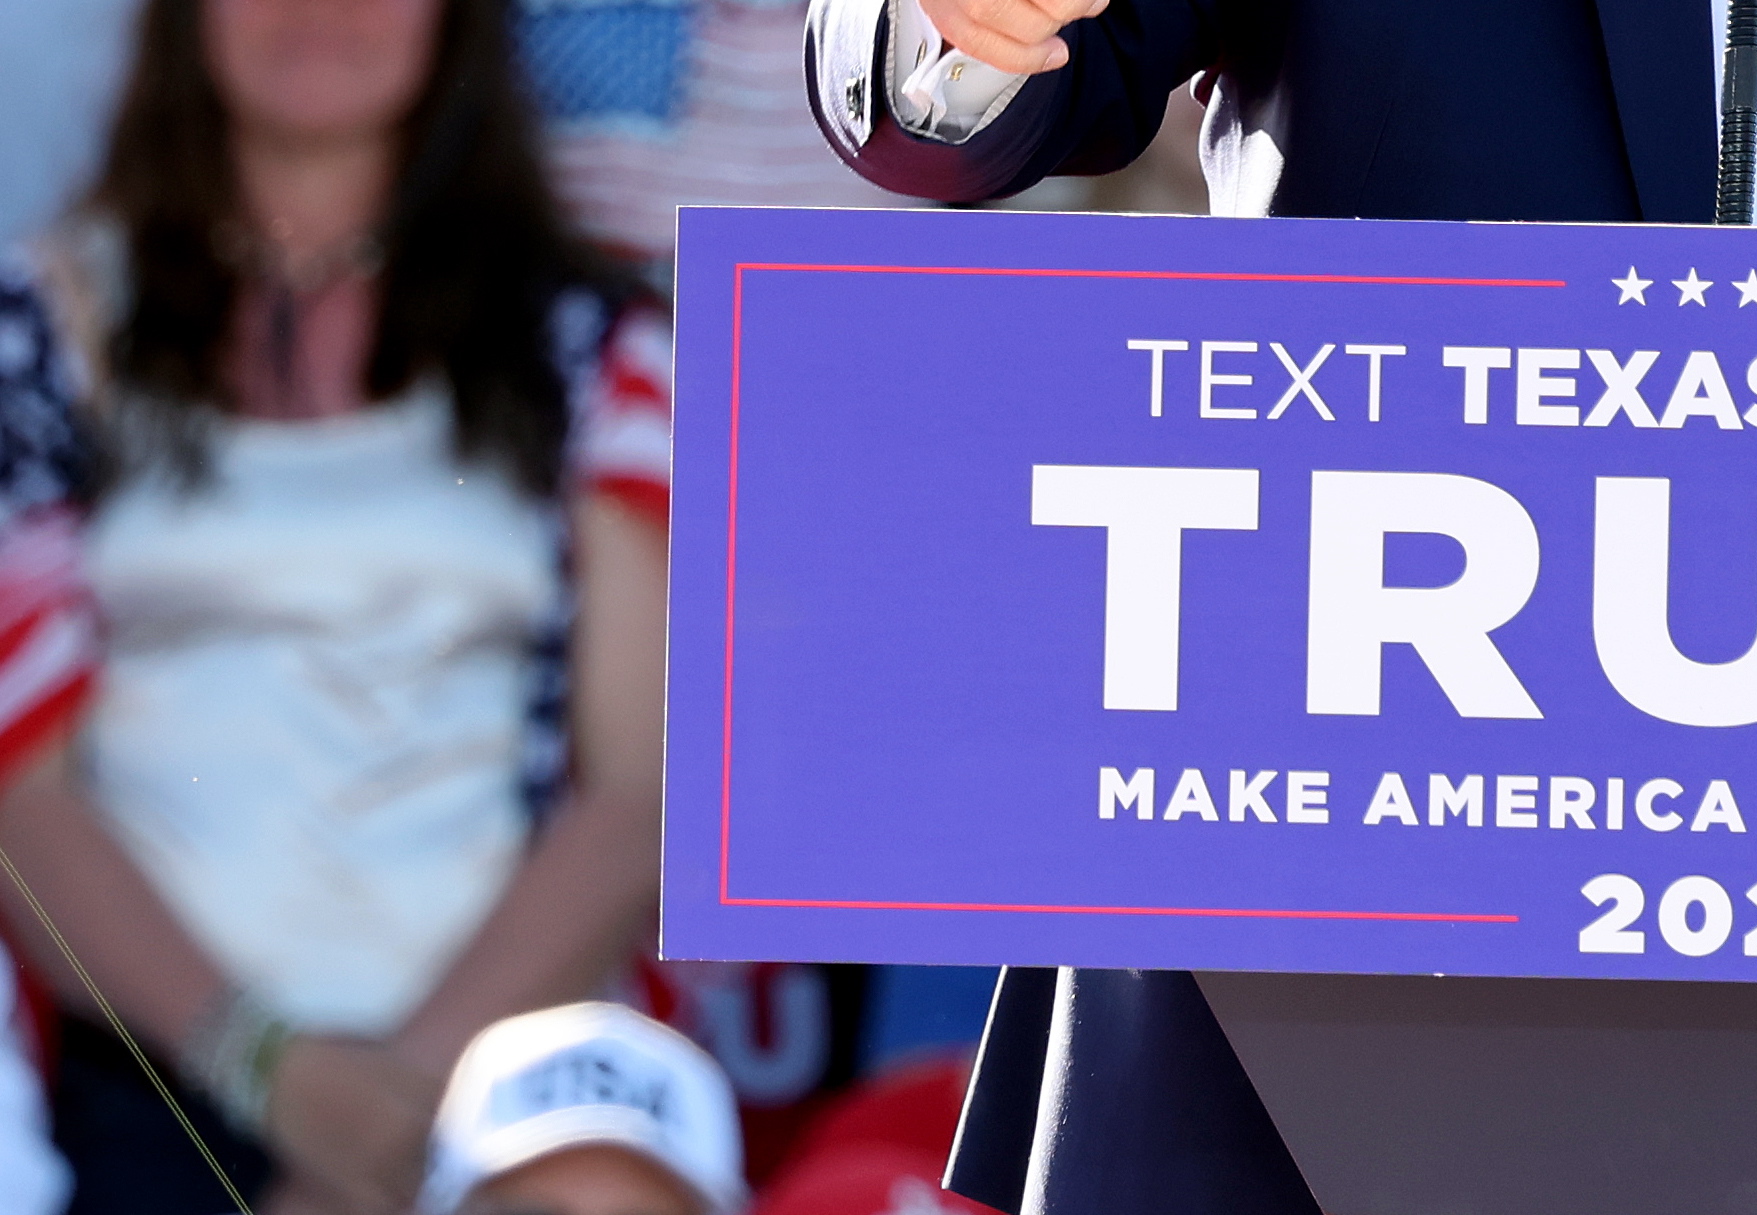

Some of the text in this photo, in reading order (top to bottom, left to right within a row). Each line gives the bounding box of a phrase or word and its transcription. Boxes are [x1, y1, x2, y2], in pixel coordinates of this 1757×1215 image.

[1126, 339, 1407, 422] TEXT
[1098, 766, 1330, 824] MAKE
[1363, 772, 1747, 833] AMERICA
